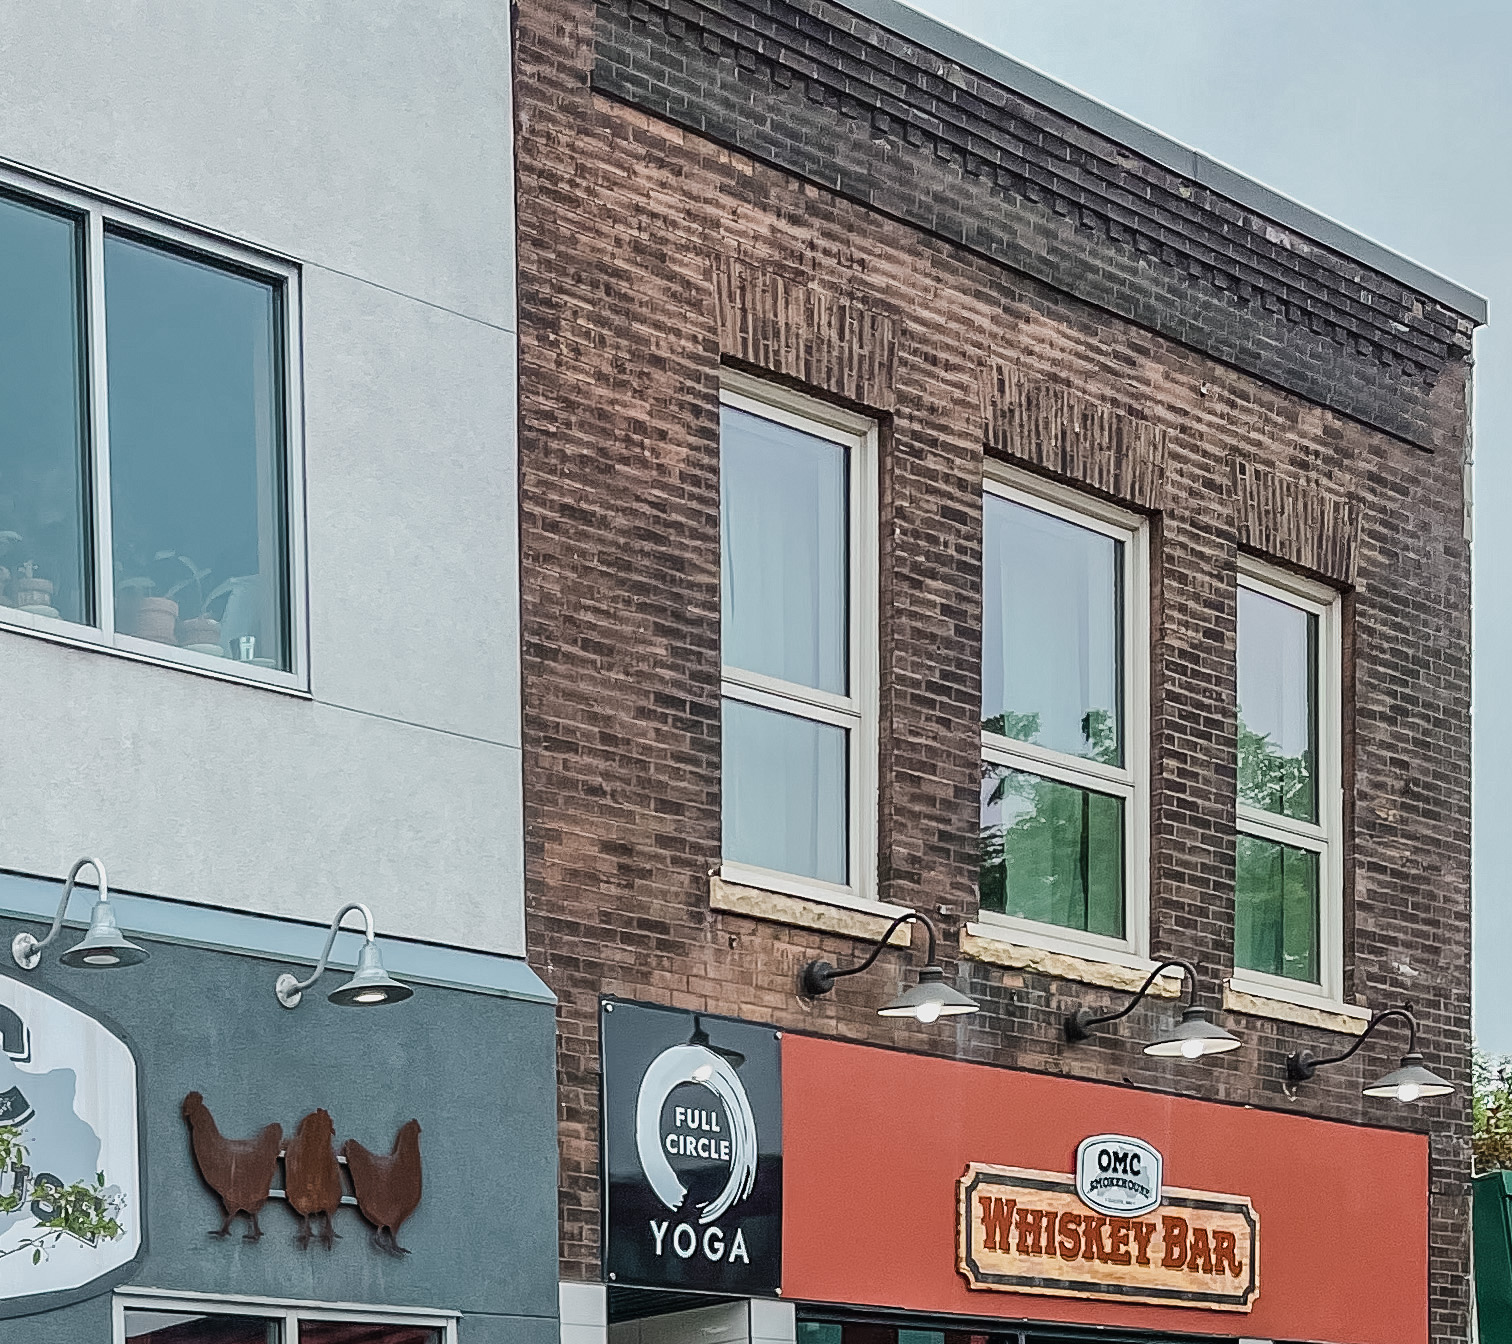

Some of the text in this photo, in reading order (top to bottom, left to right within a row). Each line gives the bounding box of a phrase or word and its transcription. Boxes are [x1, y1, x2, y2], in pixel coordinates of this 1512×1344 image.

[674, 1106, 721, 1133] FULL
[665, 1133, 730, 1161] CIRCLE
[1097, 1148, 1141, 1177] OMC
[649, 1219, 750, 1265] YOGA
[978, 1196, 1243, 1278] WHISKEY BAR
